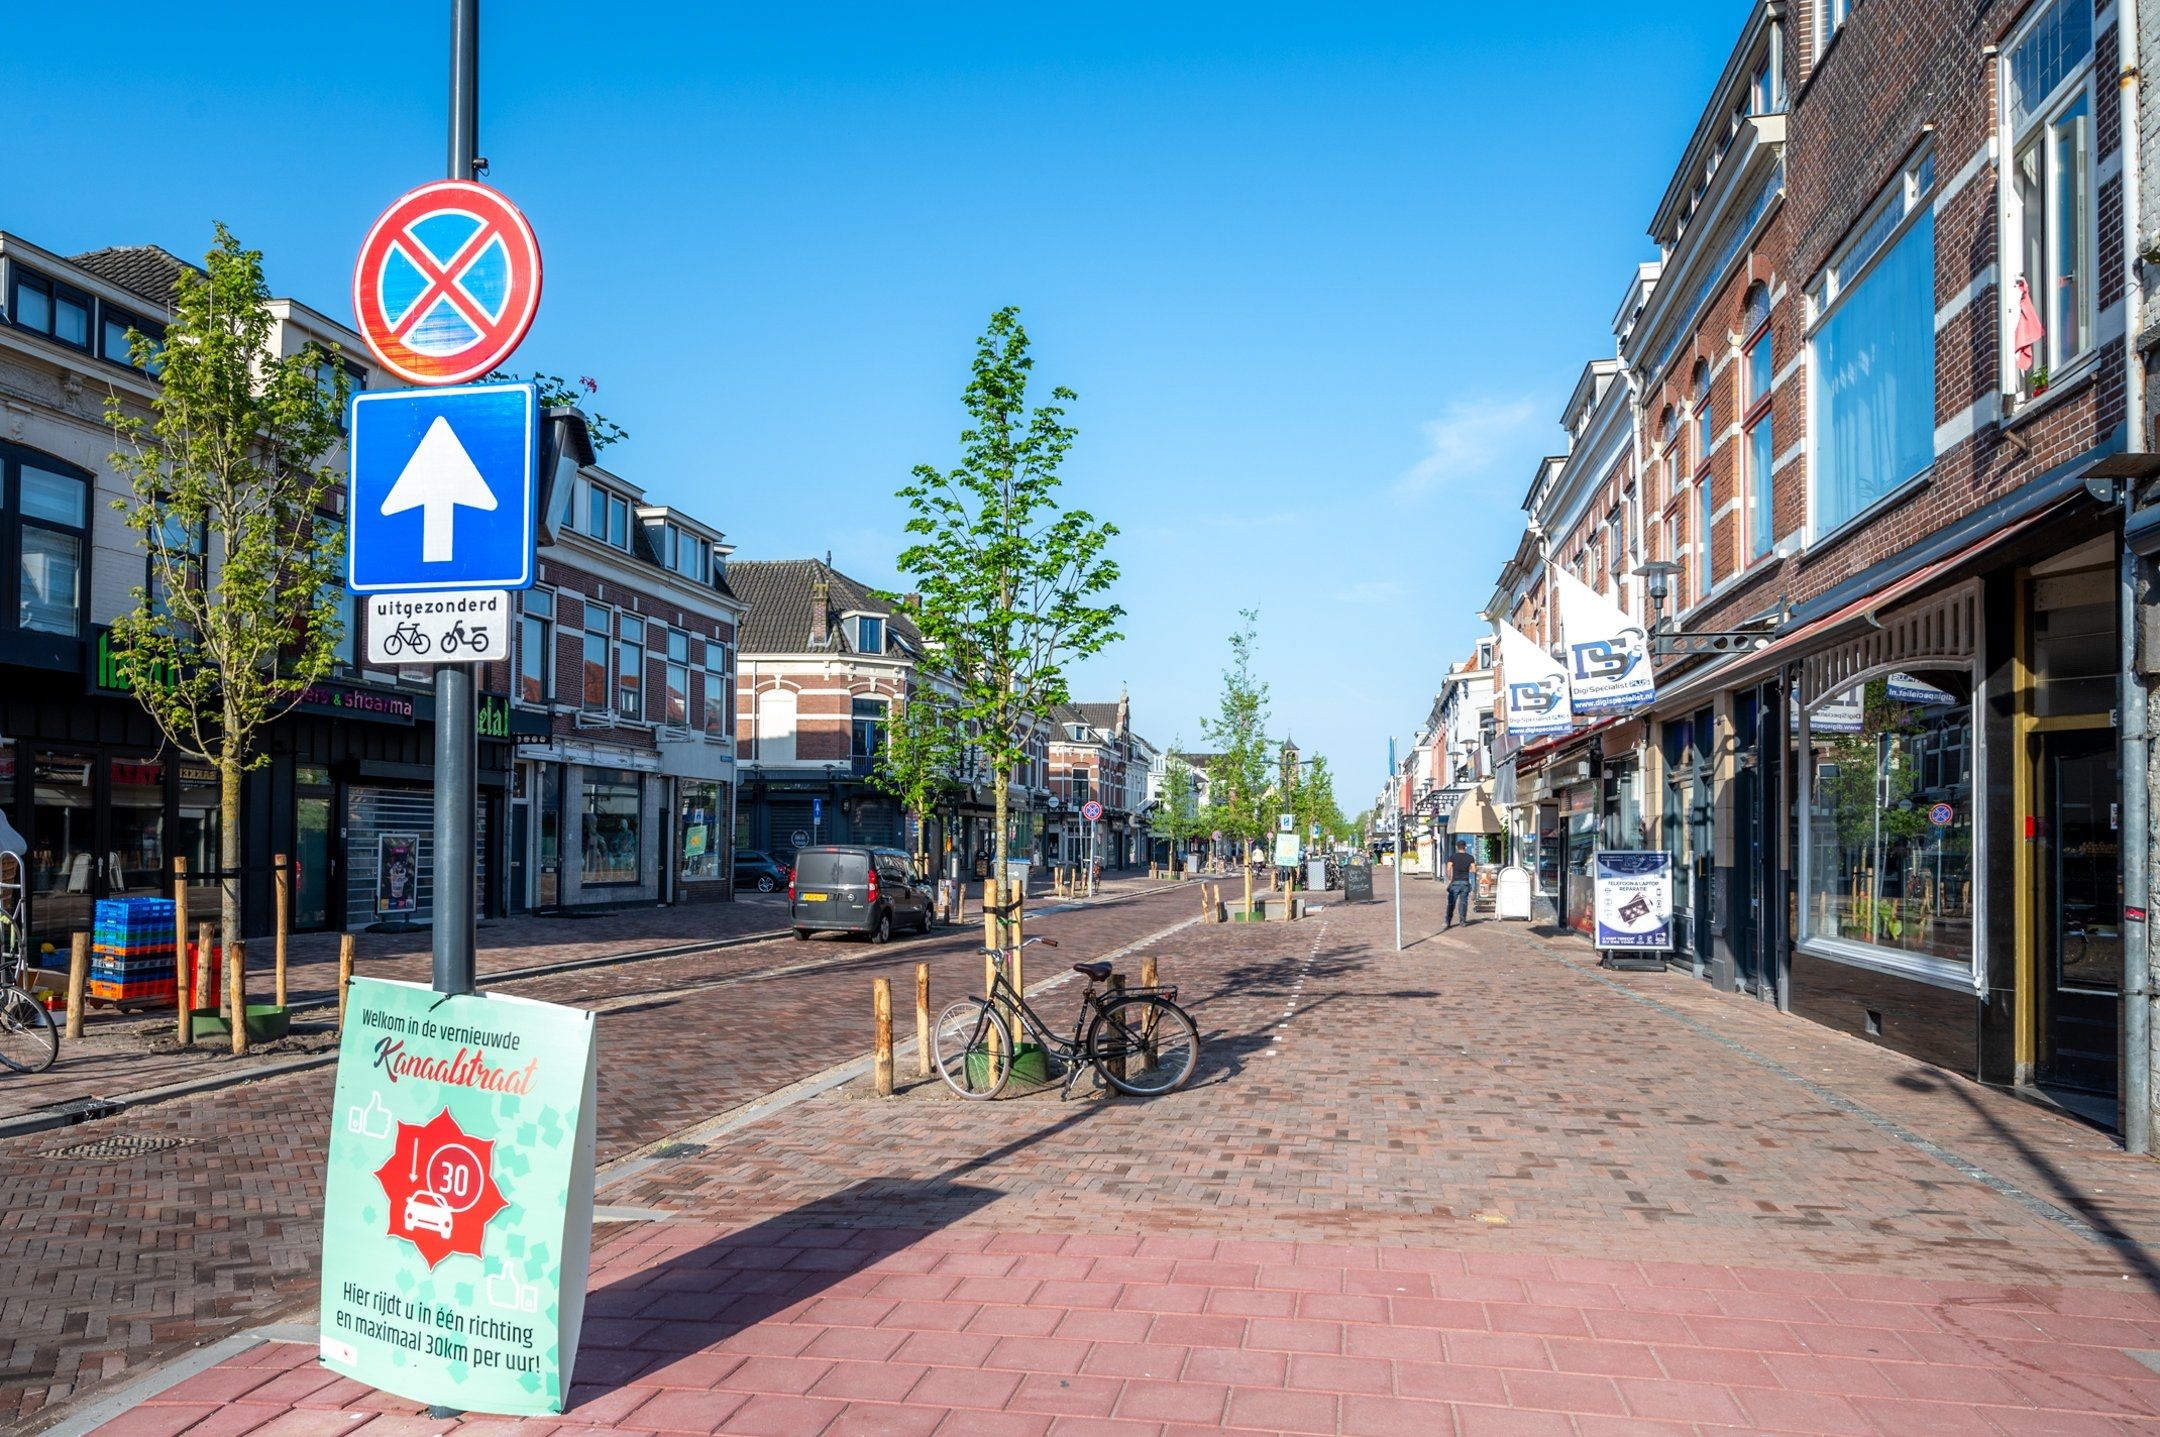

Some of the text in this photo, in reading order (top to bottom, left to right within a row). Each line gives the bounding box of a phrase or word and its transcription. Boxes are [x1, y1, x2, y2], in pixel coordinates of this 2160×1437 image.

[378, 597, 497, 619] uitgezonderd
[333, 693, 343, 706] &
[345, 689, 413, 716] shoarma
[1575, 692, 1653, 708] www.digispecialist.nl
[362, 1008, 520, 1051] Welkom in de vernieuwde
[373, 1036, 538, 1096] Kanaalstraat
[439, 1161, 469, 1197] 30
[343, 1281, 534, 1349] Hier rijdt u in één richting
[336, 1310, 541, 1373] en maximaal 30km per uur!
